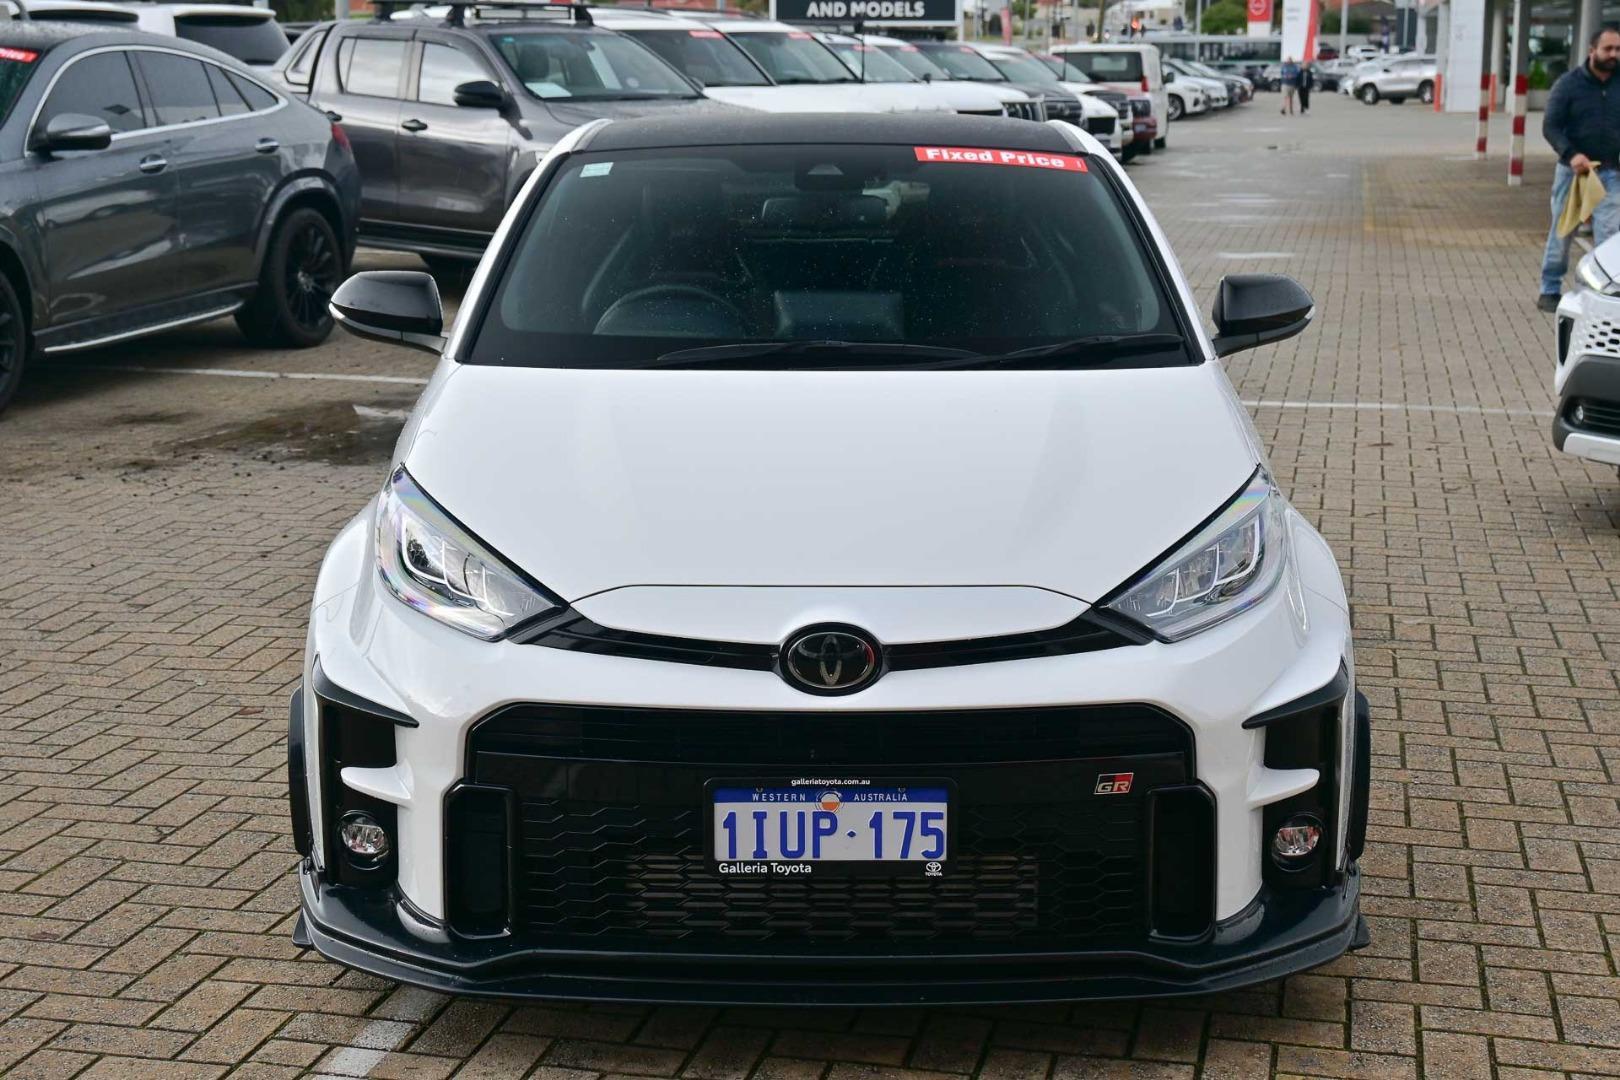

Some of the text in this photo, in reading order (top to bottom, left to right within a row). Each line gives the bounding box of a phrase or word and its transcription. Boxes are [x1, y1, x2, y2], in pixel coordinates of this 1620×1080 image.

[806, 1, 925, 18] AND MODELS
[925, 148, 1065, 168] Fixed Price
[791, 778, 871, 787] galleriatoyota.com.au
[1097, 781, 1129, 793] GR
[752, 793, 908, 801] WESTERN AUSTRALIA
[718, 862, 812, 876] Galleria Toyota
